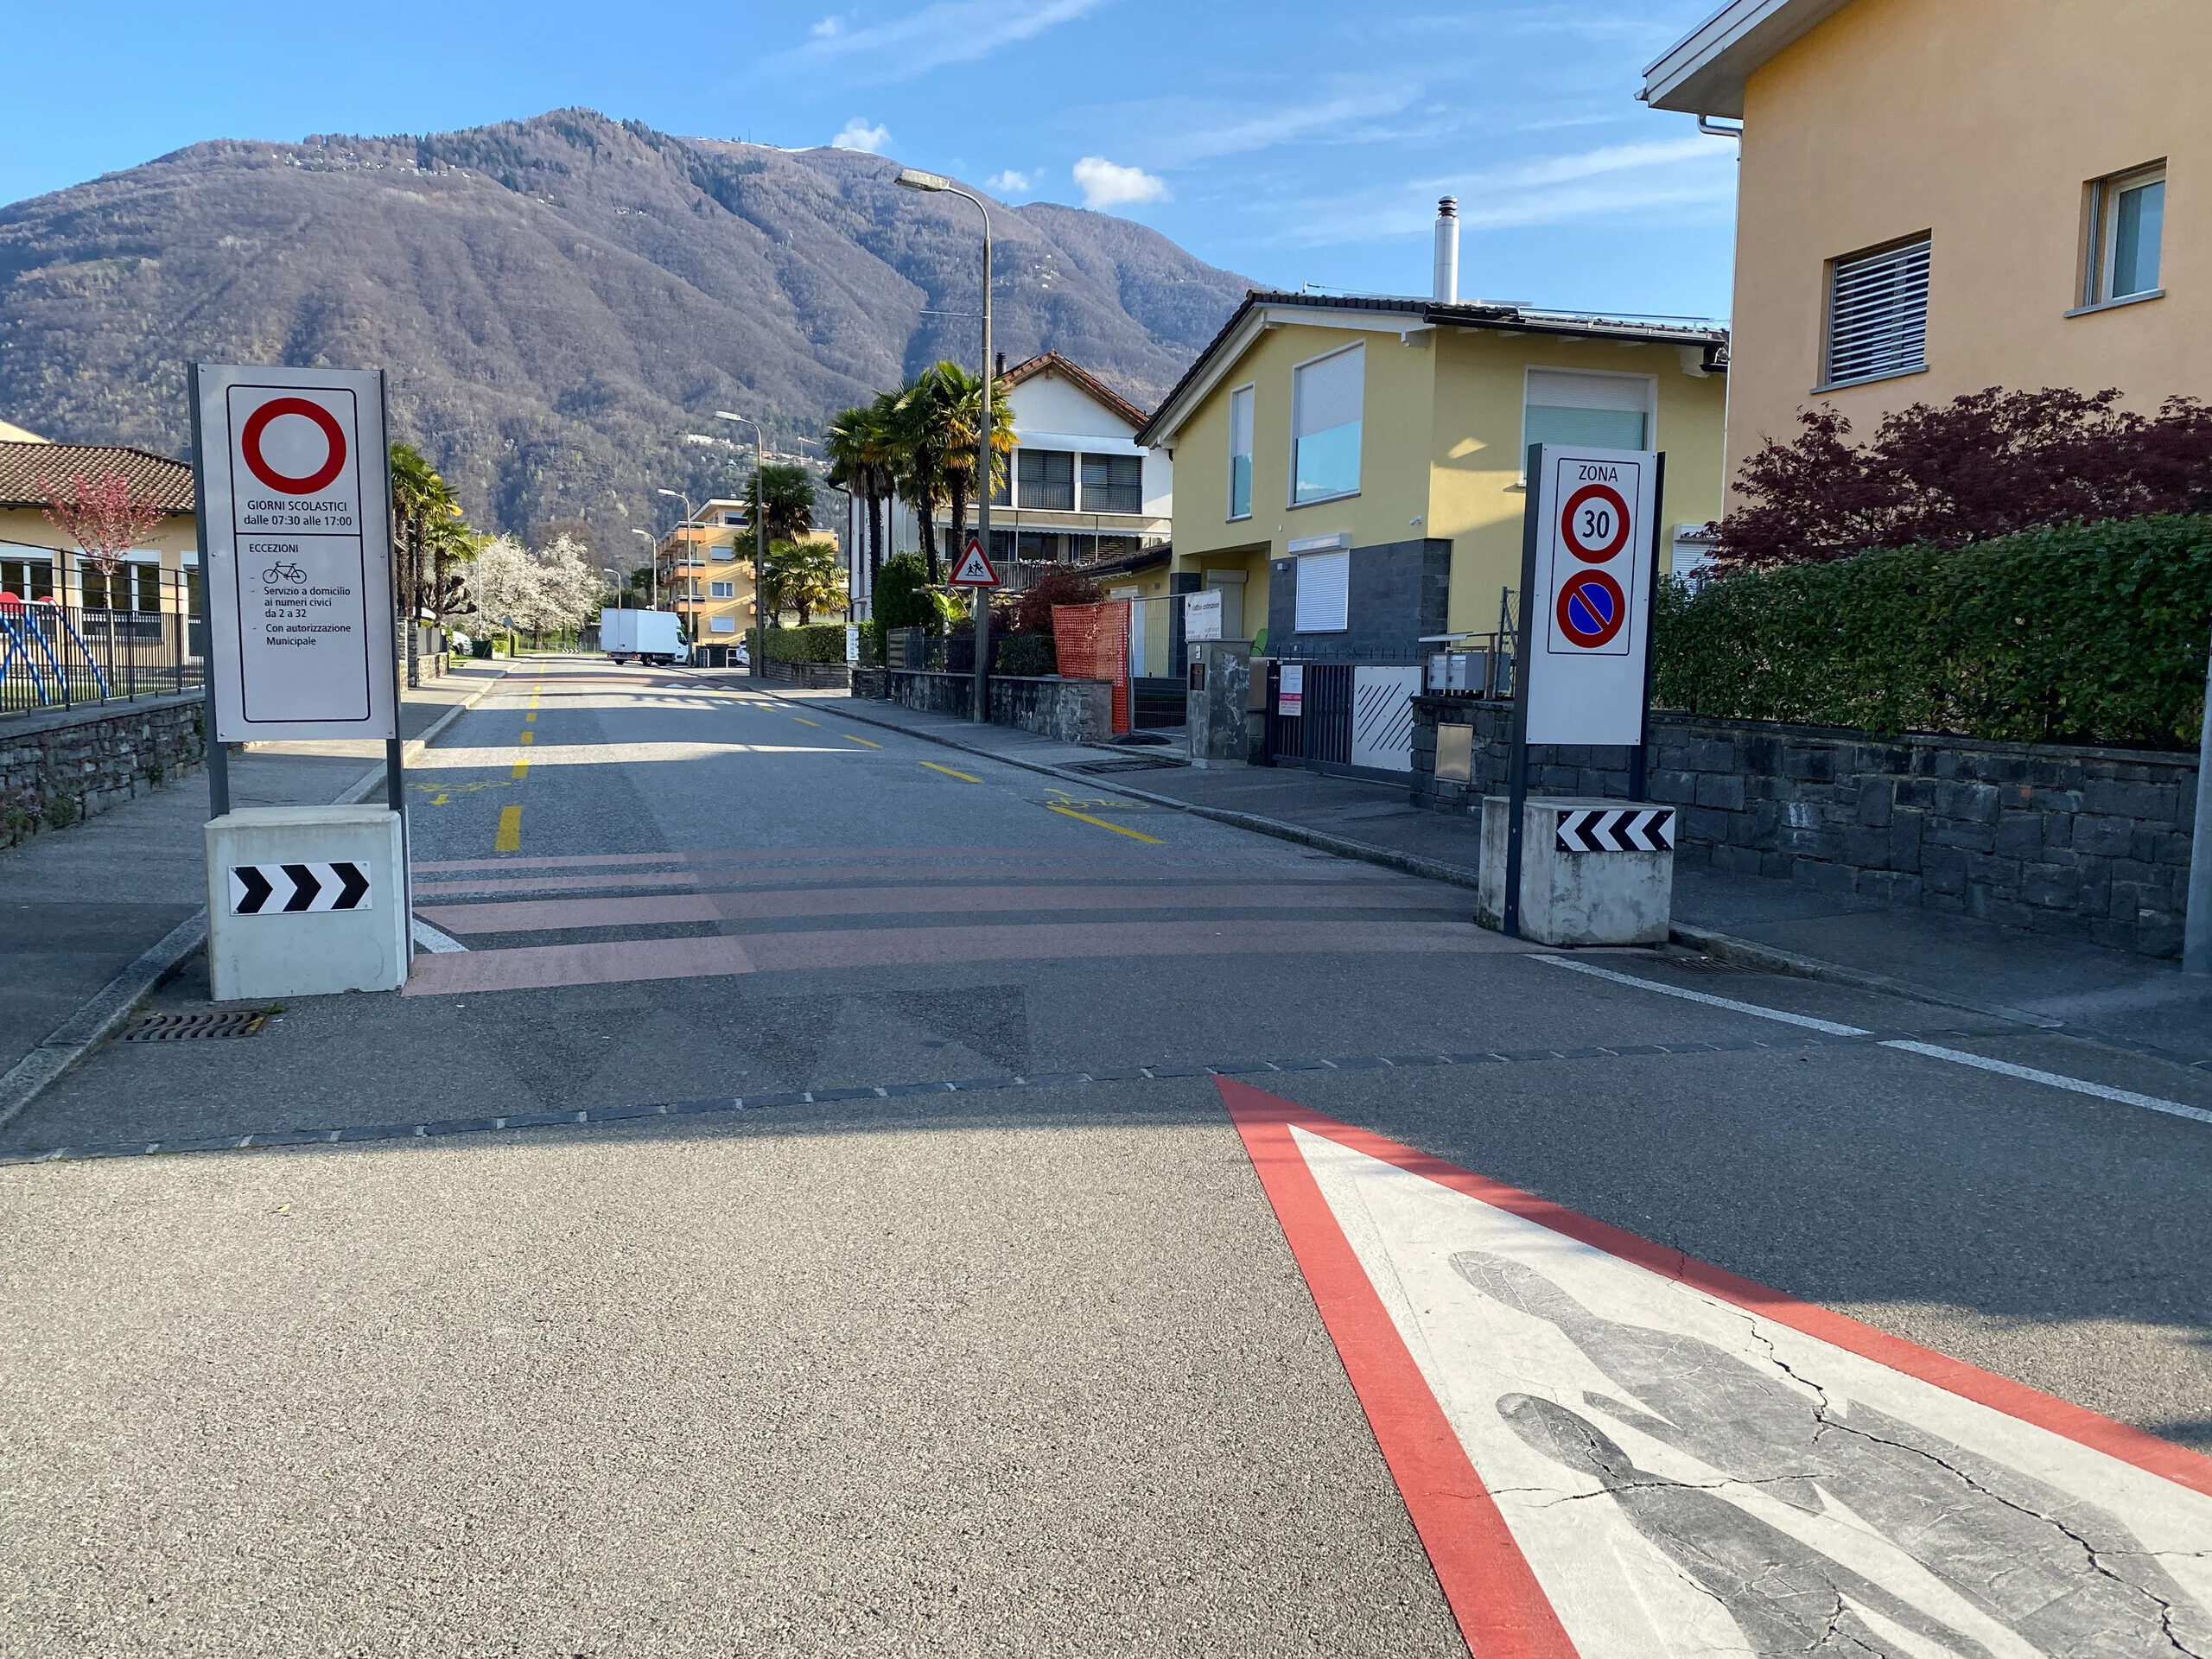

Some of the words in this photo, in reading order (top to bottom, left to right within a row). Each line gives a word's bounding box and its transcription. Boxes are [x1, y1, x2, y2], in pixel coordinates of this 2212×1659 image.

[1579, 465, 1618, 482] ZONA
[247, 500, 285, 511] GIORNI
[288, 501, 347, 512] SCOLASTICI
[244, 515, 269, 525] dalle
[271, 515, 301, 525] 07:30
[302, 516, 321, 526] alle
[324, 517, 353, 526] 17:00
[1582, 510, 1610, 539] 30
[249, 543, 299, 553] ECCEZIONI
[264, 587, 300, 595] Servizio
[309, 587, 351, 595] domicilio
[264, 598, 273, 607] ai
[275, 598, 307, 607] numeri
[309, 598, 332, 607] civici
[264, 609, 276, 618] da
[278, 609, 284, 618] 2
[296, 609, 307, 618] 32
[265, 624, 284, 632] Con
[286, 624, 352, 632] autorizzazione
[266, 637, 316, 647] Municipale
